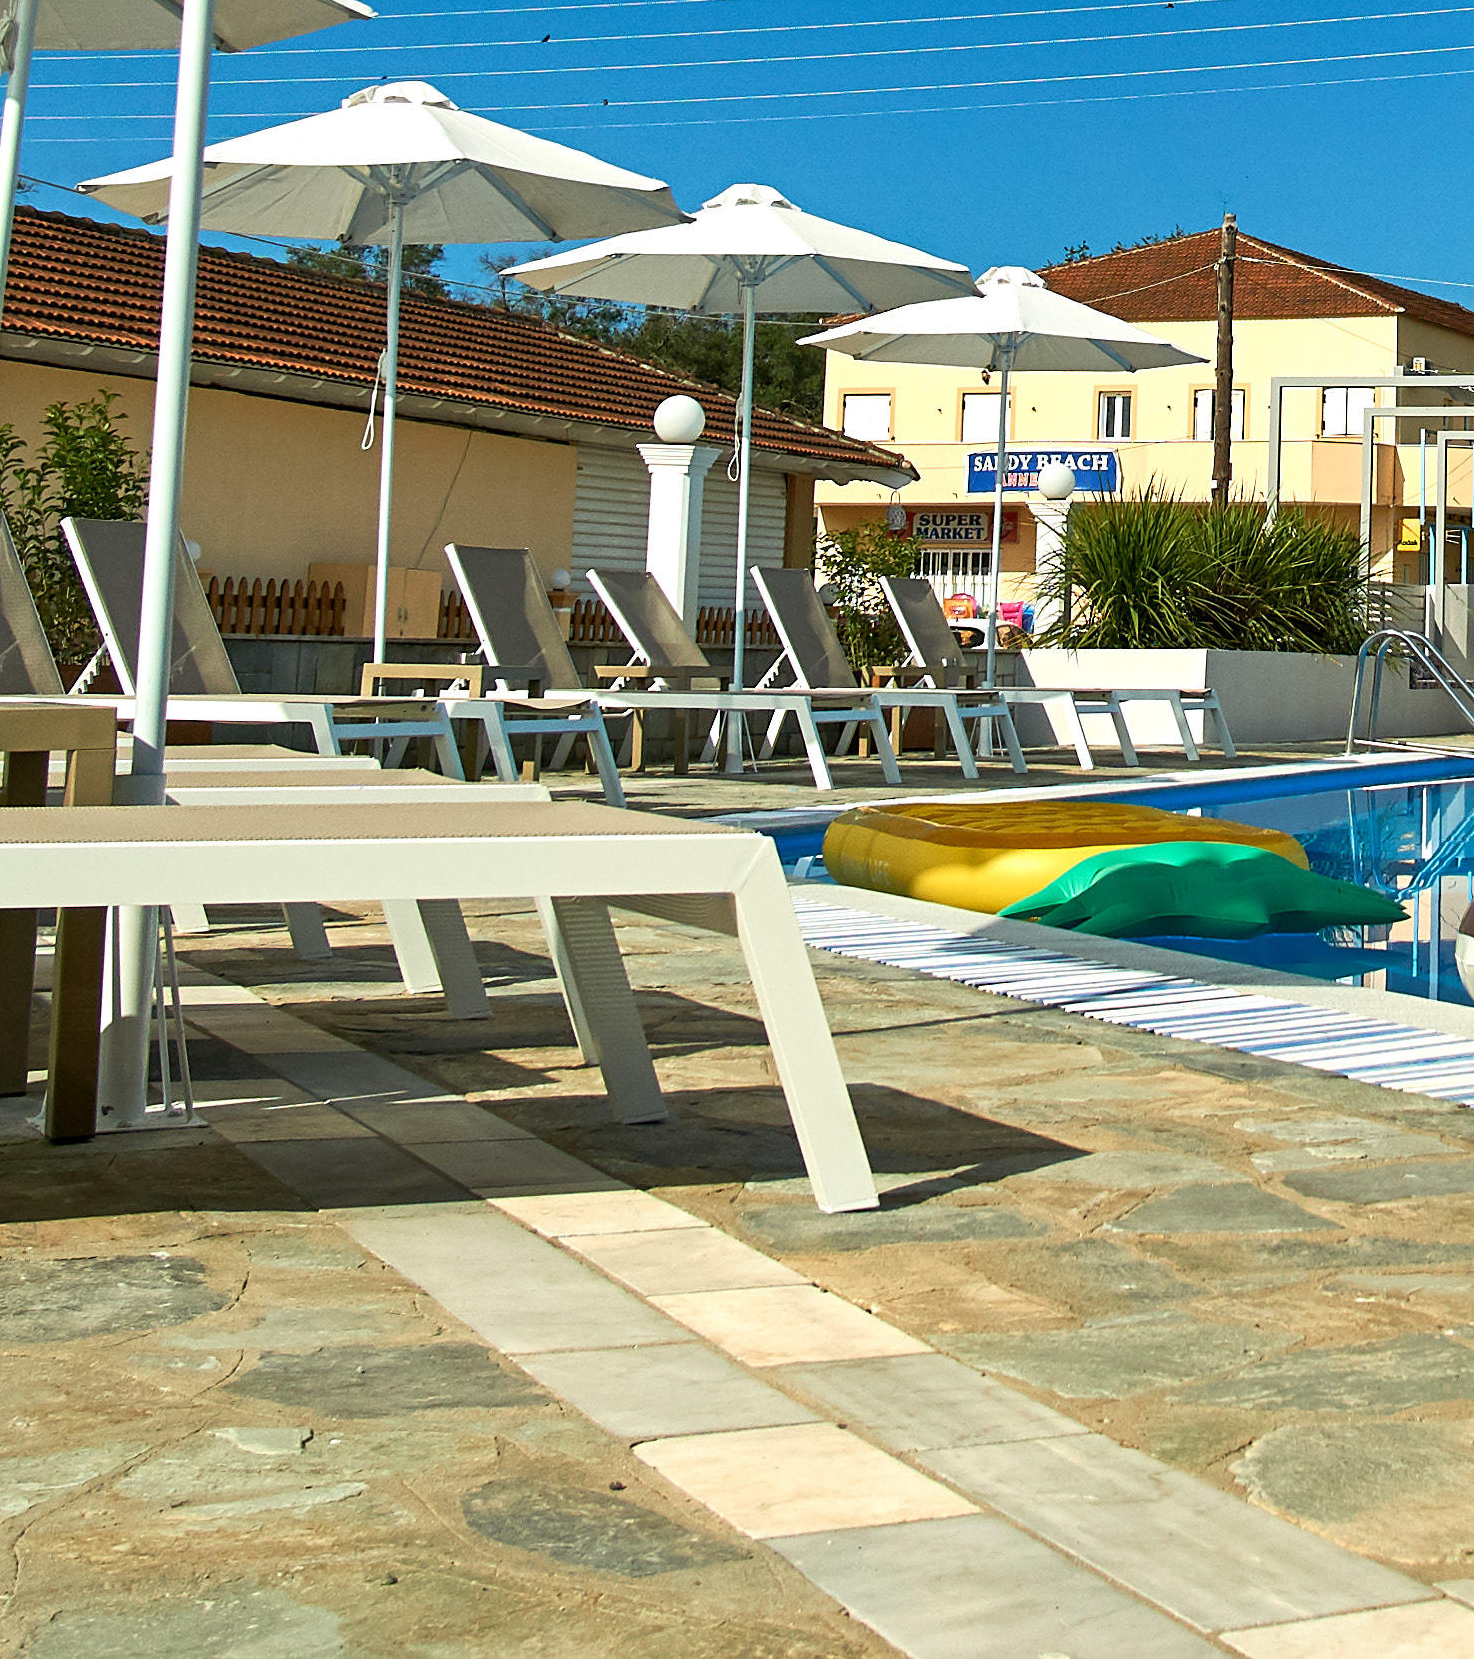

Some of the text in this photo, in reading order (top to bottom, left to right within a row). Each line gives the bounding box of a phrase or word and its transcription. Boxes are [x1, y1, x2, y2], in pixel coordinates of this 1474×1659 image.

[1001, 472, 1039, 487] ANNE
[918, 514, 982, 526] SUPER
[915, 527, 984, 540] MARKET
